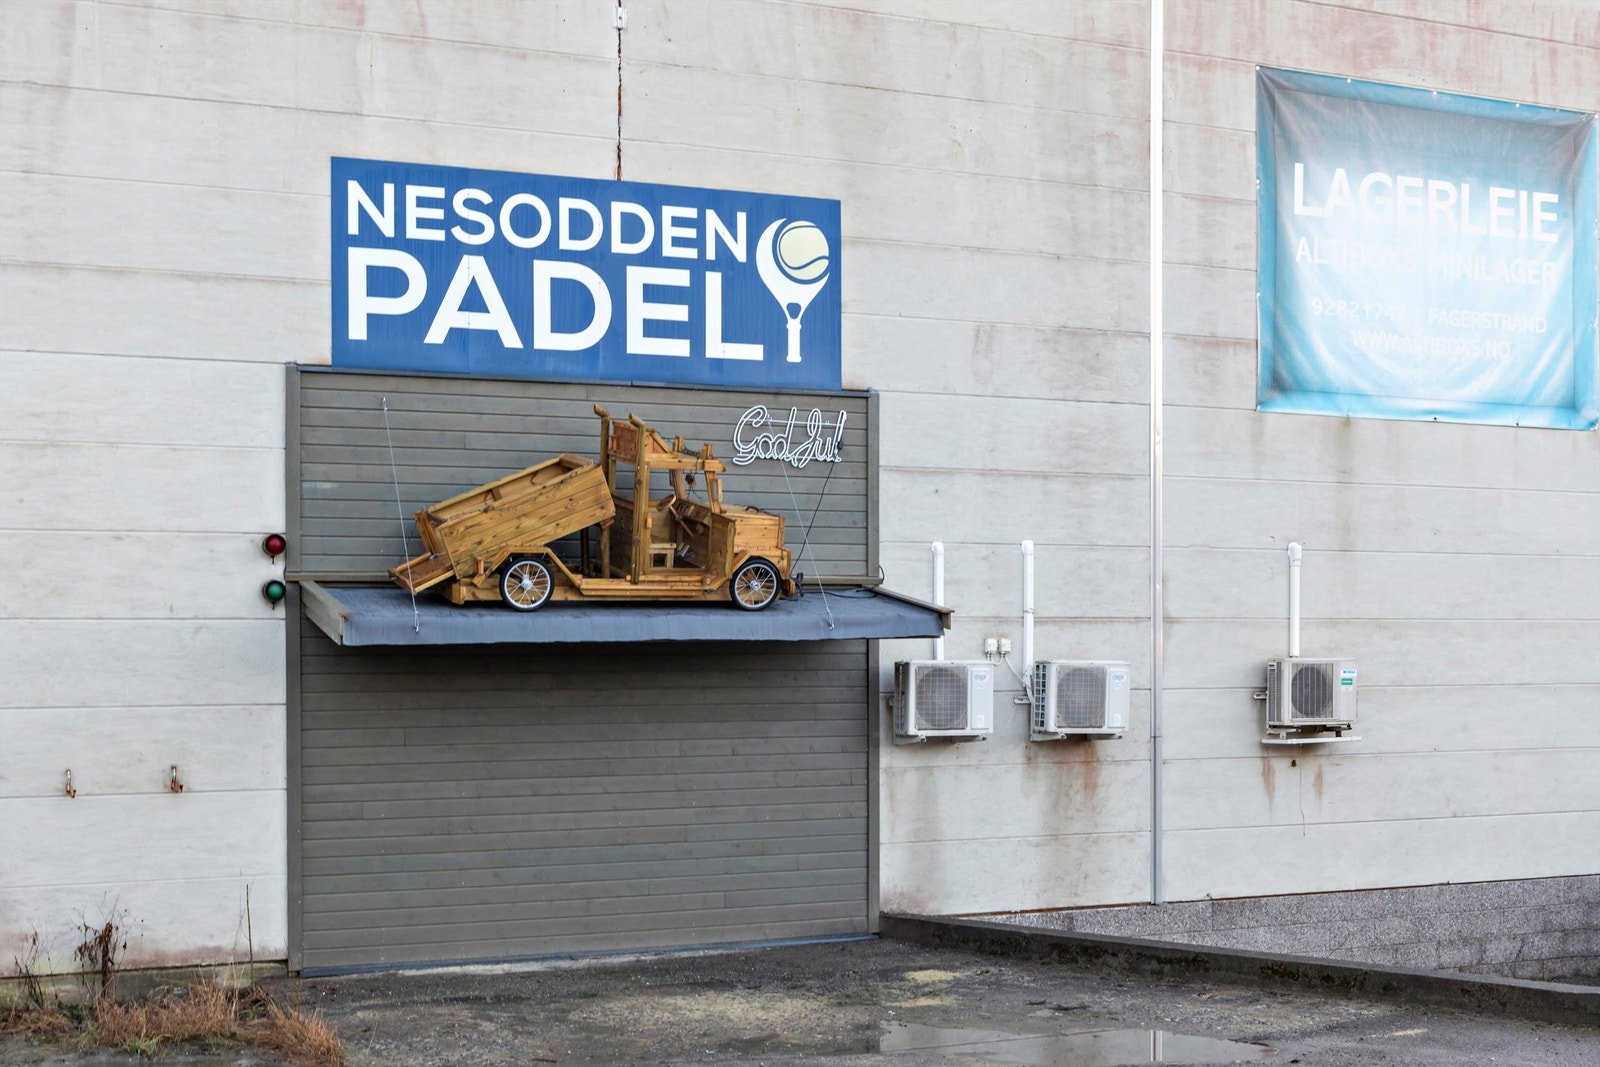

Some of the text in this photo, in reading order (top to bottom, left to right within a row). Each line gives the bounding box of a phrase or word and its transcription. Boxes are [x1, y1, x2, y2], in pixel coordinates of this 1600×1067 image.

[347, 180, 748, 263] NESODDEN
[1294, 162, 1559, 243] LAGERLEIE
[1428, 248, 1558, 287] MINILAGER
[347, 246, 764, 361] PADEL
[1429, 307, 1547, 333] FAGERSTRAND
[733, 405, 797, 466] God
